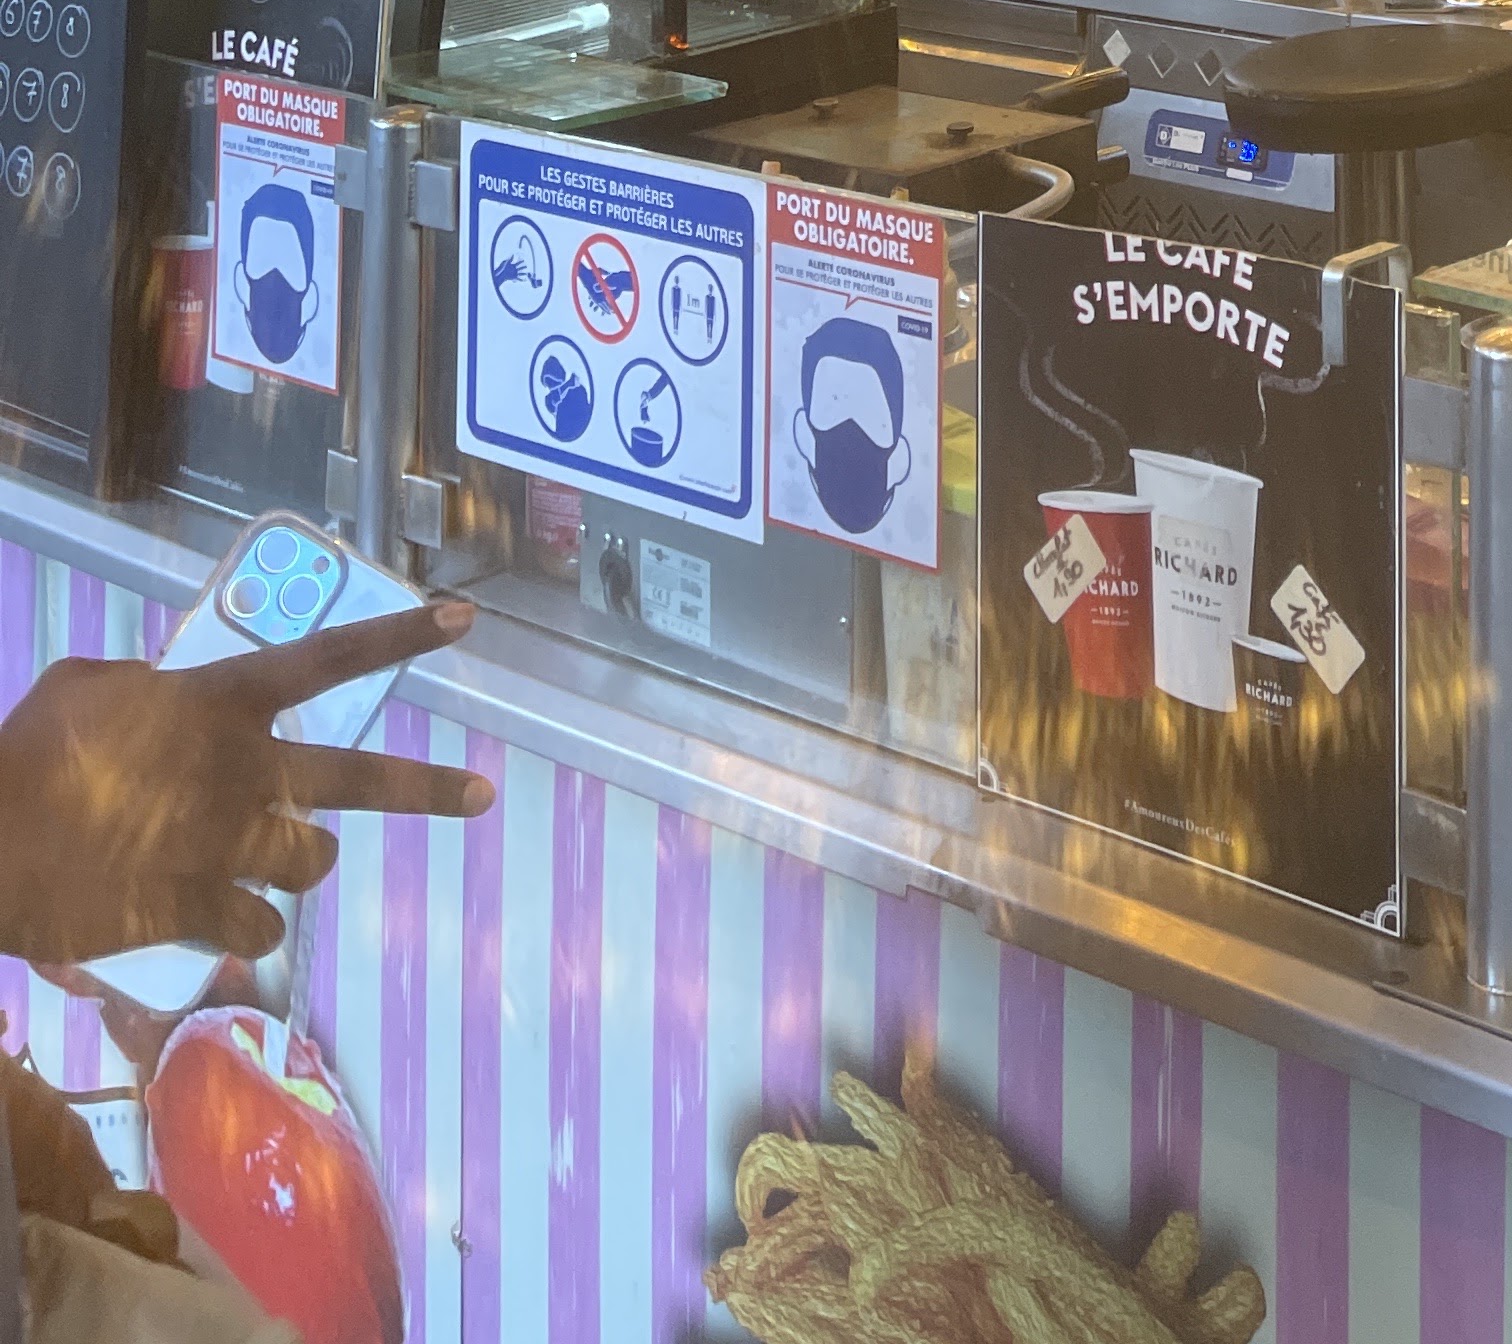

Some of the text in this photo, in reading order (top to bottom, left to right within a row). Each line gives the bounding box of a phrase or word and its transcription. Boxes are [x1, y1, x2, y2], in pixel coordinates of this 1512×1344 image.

[212, 30, 300, 78] LE CAFÉ
[224, 79, 338, 121] PORT DU MASQUE
[236, 102, 324, 138] OBLIGATOIRE.
[540, 165, 674, 209] LES GESTES BARRIÈRES
[478, 174, 744, 247] POUR SE PROTÉGER ET PROTÉGER LES AUTRES
[776, 191, 934, 245] PORT DU MASQUE
[794, 220, 914, 266] OBLIGATOIRE.
[1104, 232, 1145, 262] LE
[1155, 546, 1238, 587] RICHARD
[1246, 682, 1293, 708] RICHARD
